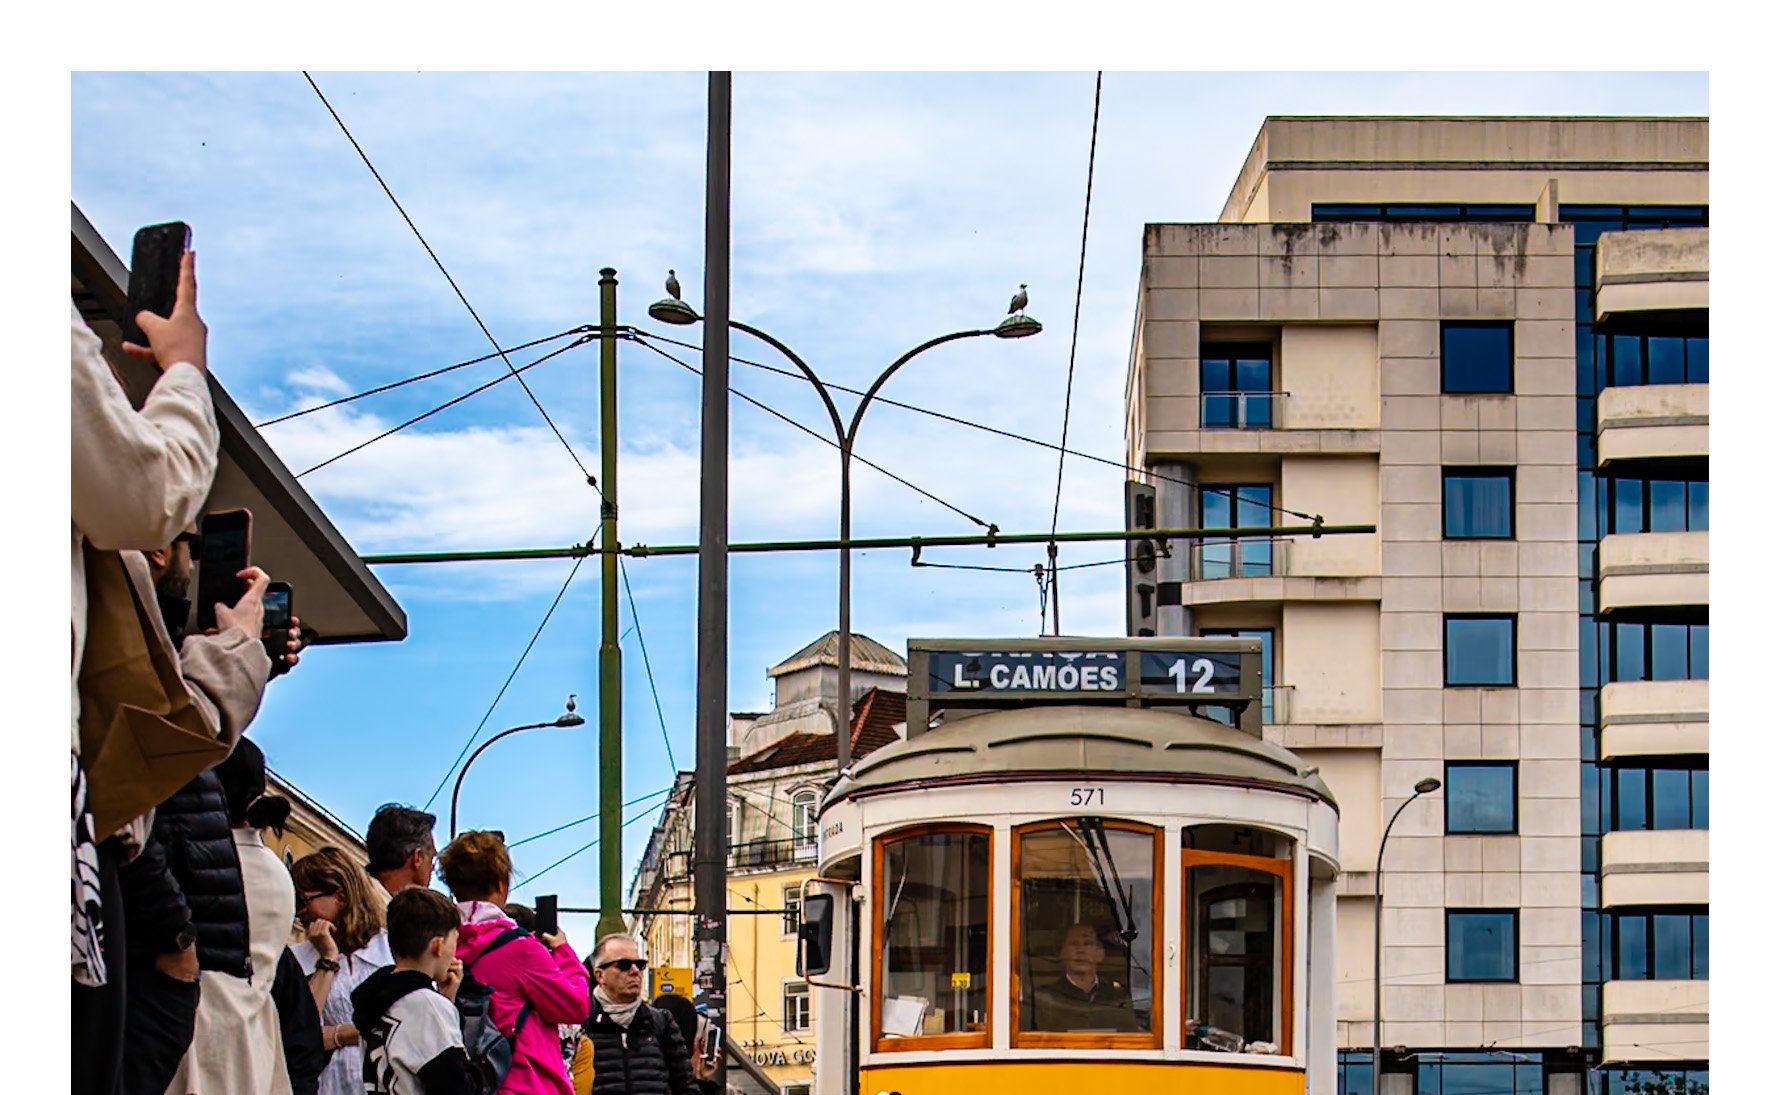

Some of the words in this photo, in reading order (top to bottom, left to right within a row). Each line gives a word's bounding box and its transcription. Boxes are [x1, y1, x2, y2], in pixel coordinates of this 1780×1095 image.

[1136, 493, 1156, 637] HOT
[954, 663, 980, 688] L.
[1168, 658, 1215, 694] 12
[1071, 788, 1104, 806] 571
